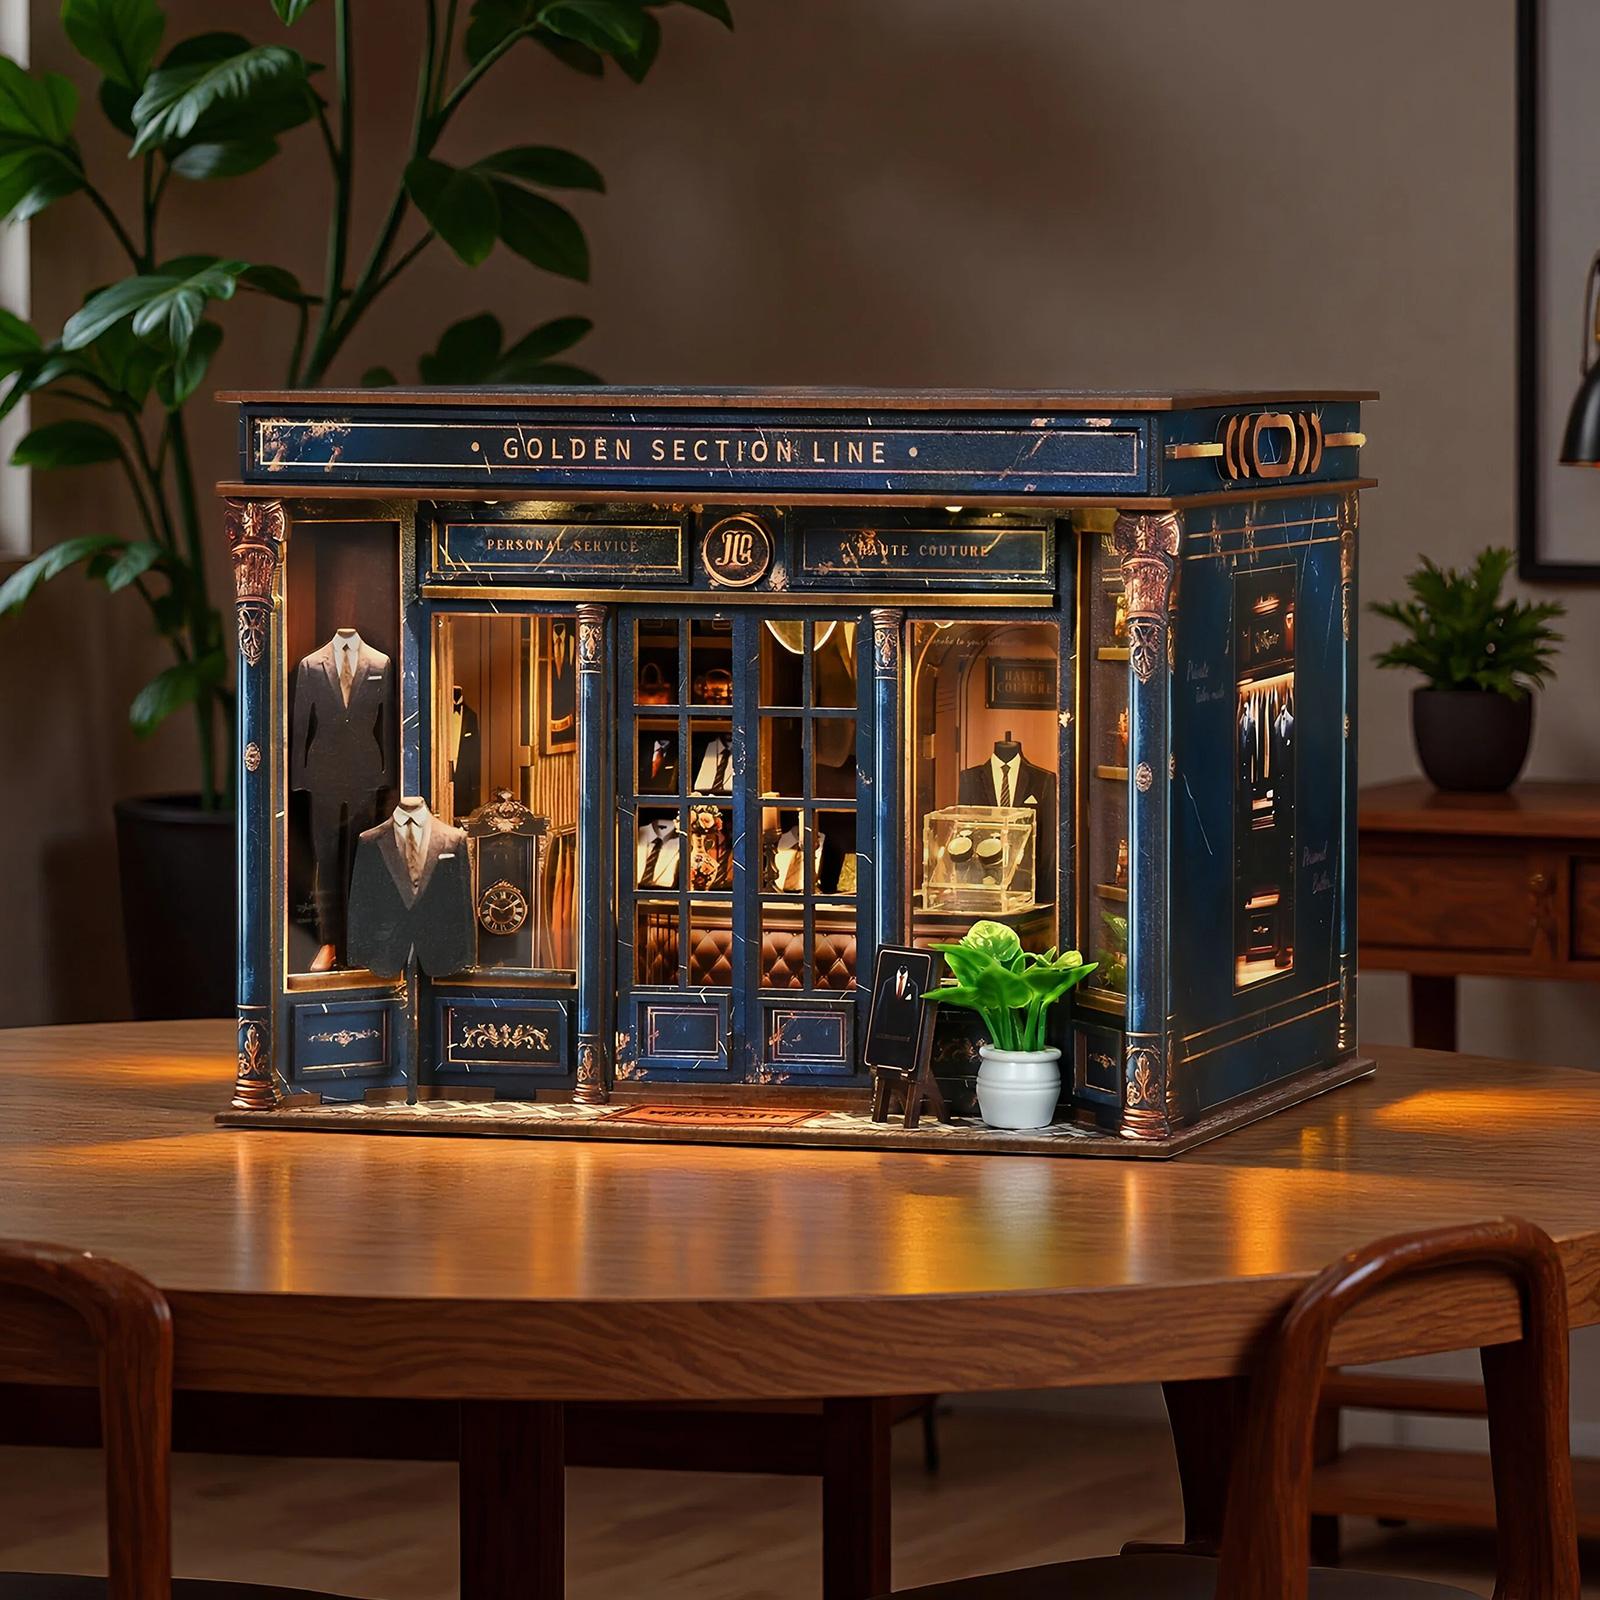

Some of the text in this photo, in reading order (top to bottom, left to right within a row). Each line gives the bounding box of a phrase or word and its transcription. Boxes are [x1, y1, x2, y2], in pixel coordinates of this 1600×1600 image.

[503, 437, 886, 464] GOLDEN SECTION LINE
[487, 538, 640, 553] PERSONAL SERVICE
[857, 544, 990, 558] HAUTE COUTURE
